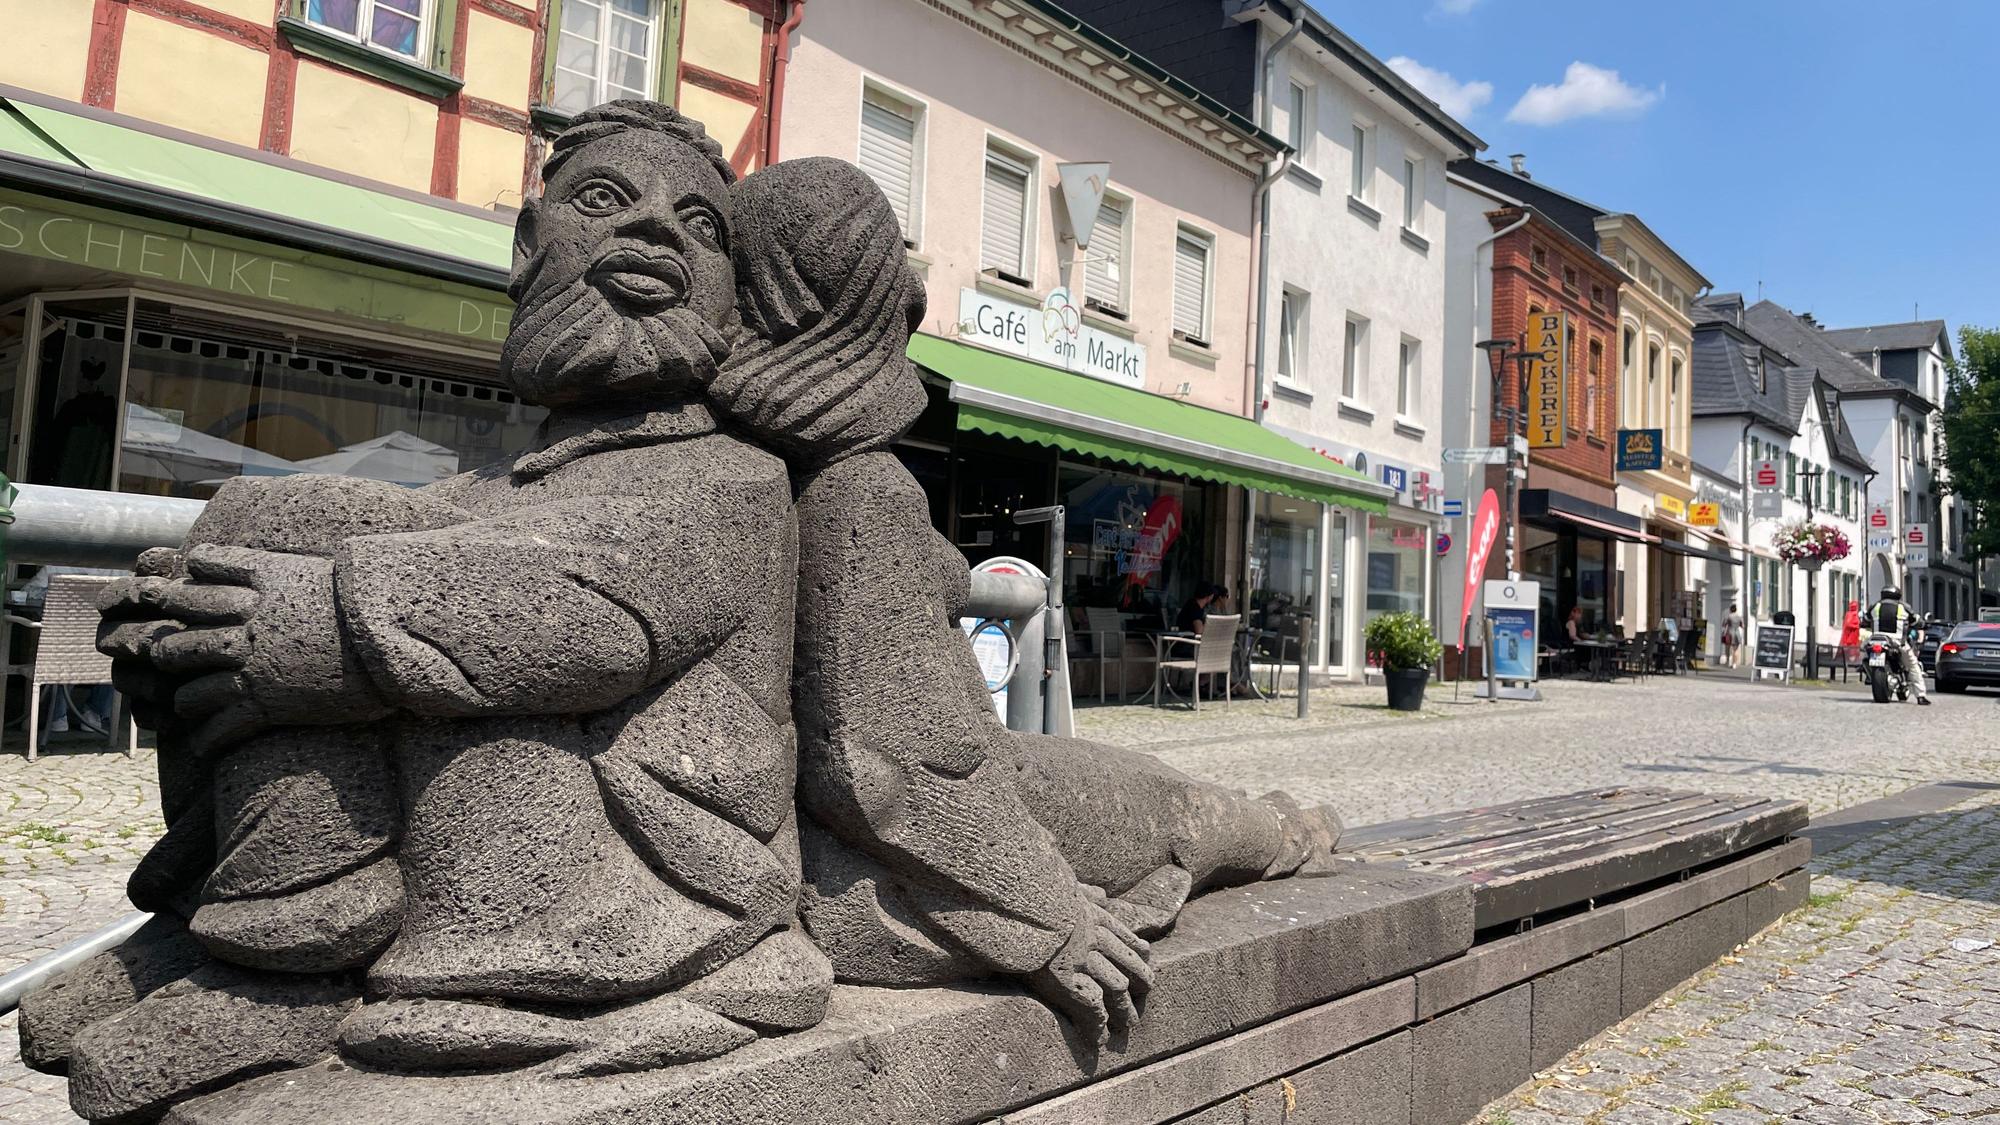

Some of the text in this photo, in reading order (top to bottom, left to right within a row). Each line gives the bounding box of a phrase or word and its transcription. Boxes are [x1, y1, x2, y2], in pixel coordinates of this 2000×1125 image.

[0, 206, 293, 301] SCHENKE
[977, 304, 1140, 378] Café am Markt
